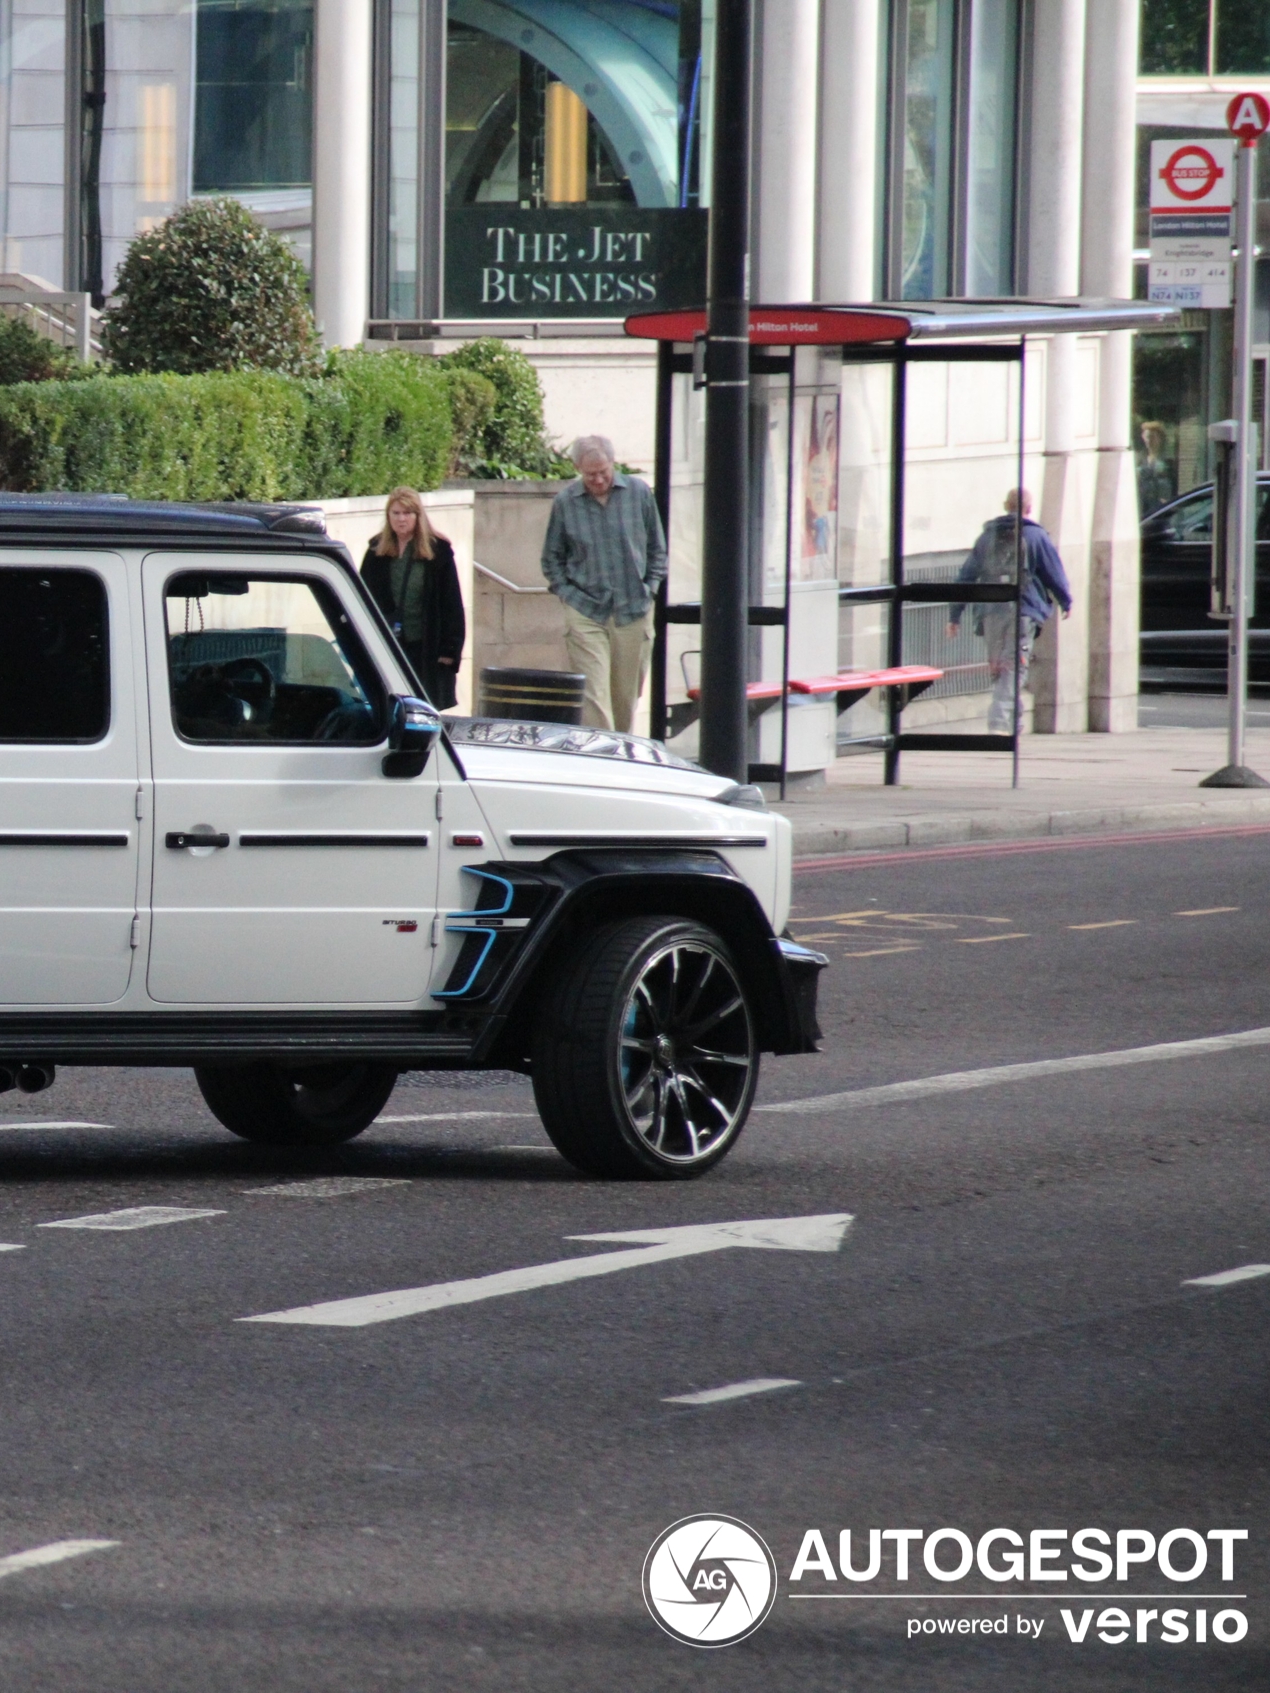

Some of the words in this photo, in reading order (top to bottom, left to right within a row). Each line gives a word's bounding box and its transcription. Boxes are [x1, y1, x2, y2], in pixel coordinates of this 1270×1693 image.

[1232, 97, 1263, 131] A
[1171, 169, 1188, 178] BUS
[1189, 169, 1211, 178] STOP
[486, 227, 568, 263] THE
[577, 226, 651, 262] JET
[1156, 268, 1168, 277] 74
[1179, 268, 1197, 277] 137
[1207, 268, 1226, 277] 414
[481, 267, 657, 303] BUSINESS
[1151, 291, 1172, 300] N74
[1174, 291, 1202, 300] N137
[756, 323, 788, 332] Hilton
[790, 323, 819, 332] Hotel
